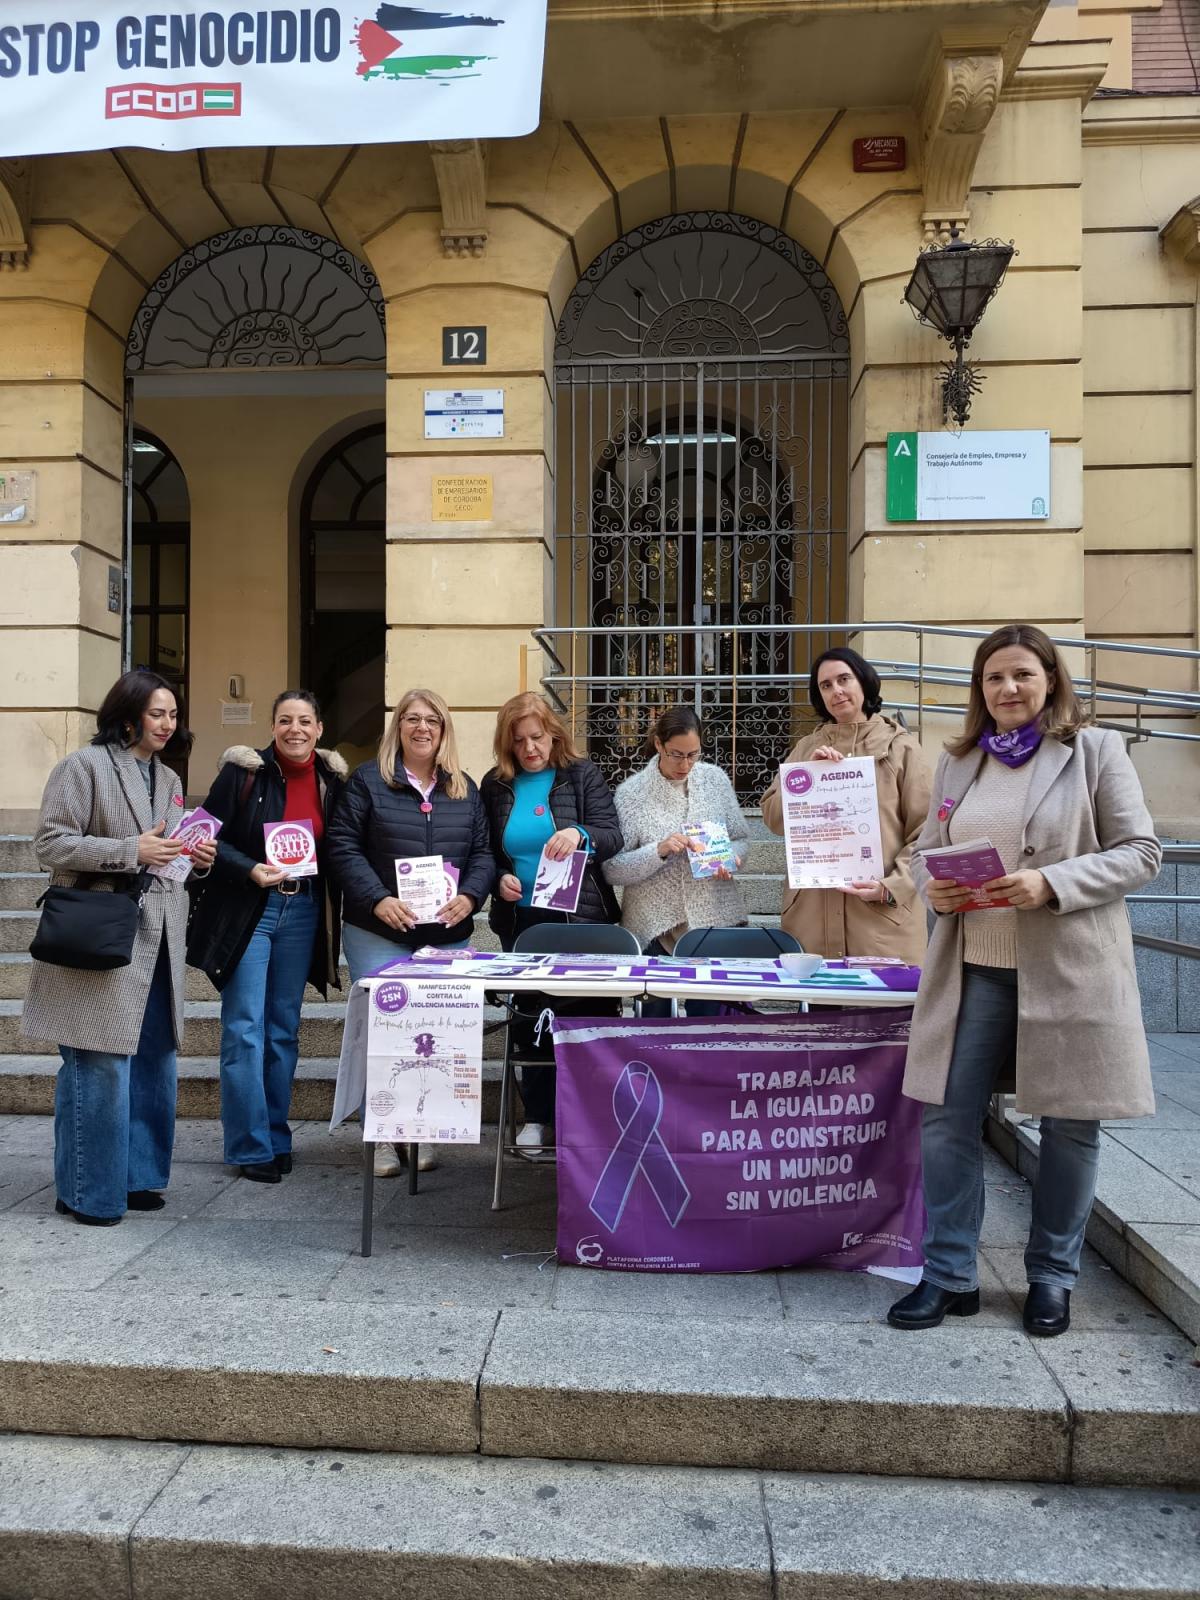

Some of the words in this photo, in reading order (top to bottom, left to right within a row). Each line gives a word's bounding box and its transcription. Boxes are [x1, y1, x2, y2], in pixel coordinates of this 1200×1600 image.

[0, 20, 99, 78] STOP
[116, 7, 341, 70] GENOCIDIO
[111, 88, 197, 113] CCOO
[449, 332, 480, 359] 12
[926, 460, 950, 468] Trabajo
[820, 770, 864, 782] AGENDA
[381, 991, 402, 1005] 25N
[737, 1064, 856, 1092] TRABAJAR
[730, 1099, 759, 1120] LA
[767, 1093, 875, 1118] IGUALDAD
[701, 1128, 763, 1152] PARA
[770, 1120, 887, 1149] CONSTRUIR
[742, 1159, 771, 1181] UN
[780, 1153, 853, 1180] MUNDO
[726, 1190, 760, 1211] SIN
[768, 1178, 878, 1209] VIOLENCIA
